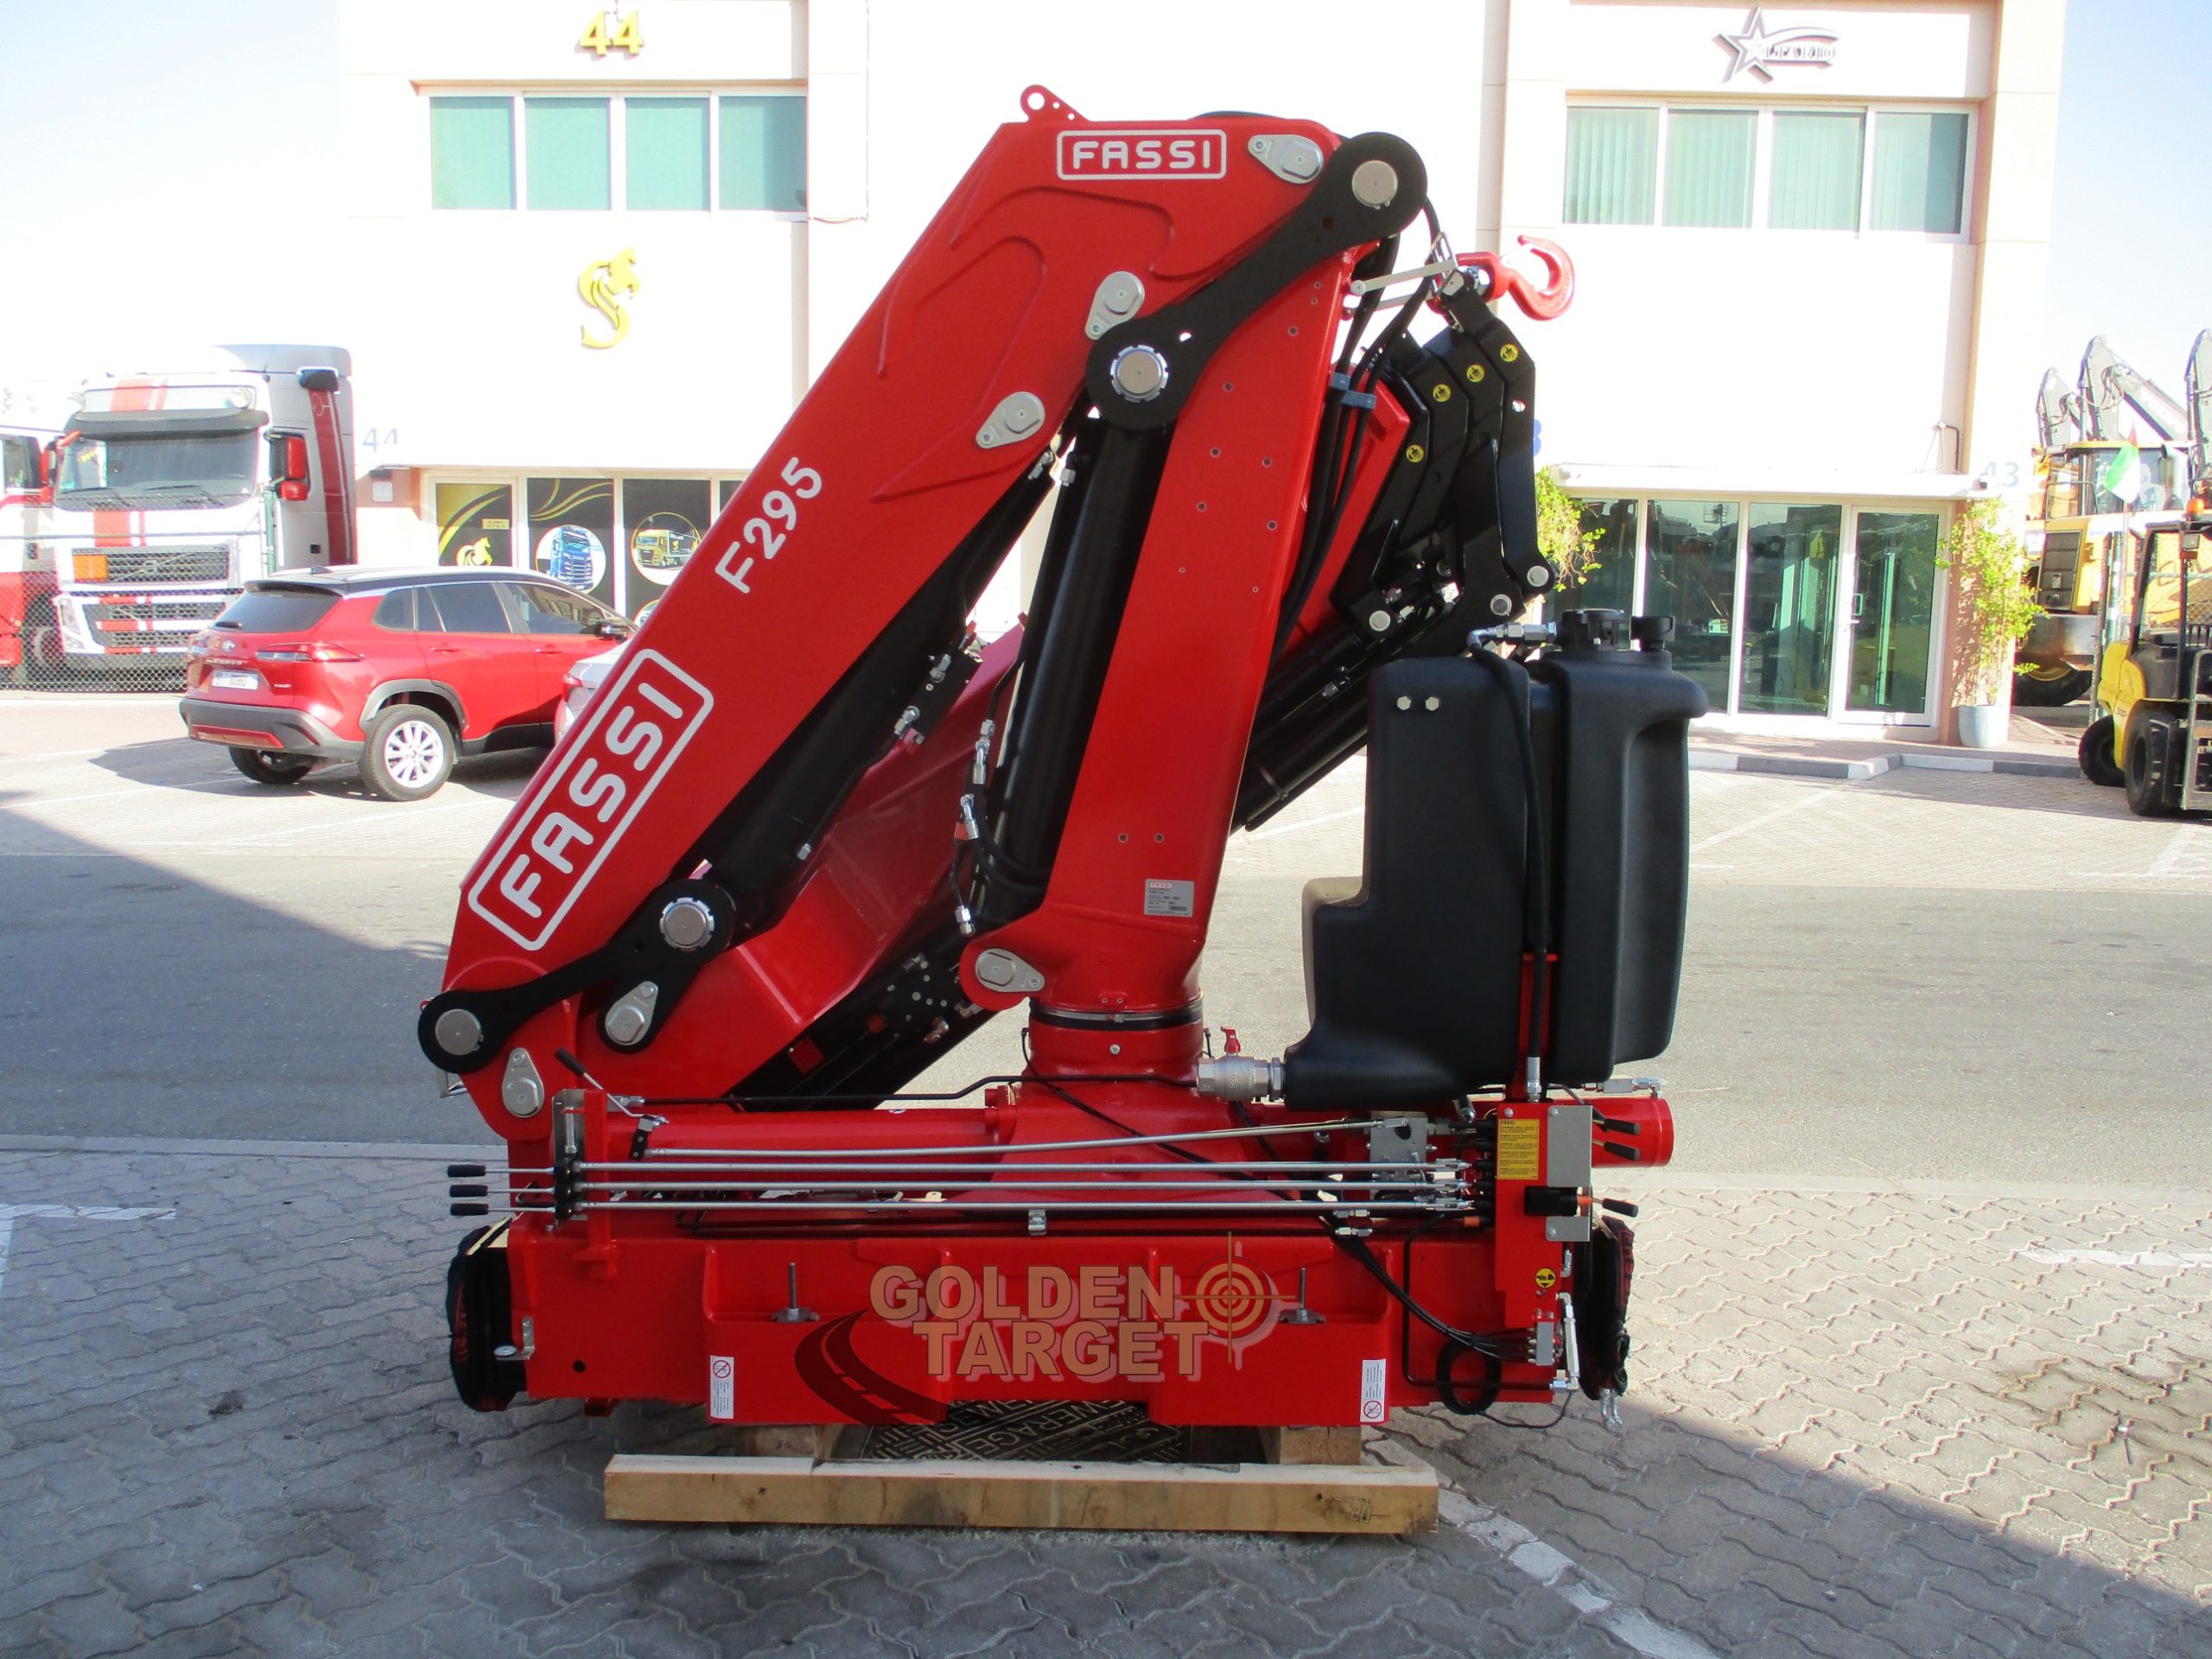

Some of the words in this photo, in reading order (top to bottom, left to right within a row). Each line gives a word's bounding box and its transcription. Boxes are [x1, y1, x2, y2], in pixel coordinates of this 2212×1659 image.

[580, 9, 645, 57] 44
[1072, 139, 1211, 169] FASSI
[715, 455, 823, 594] F295
[499, 681, 684, 919] FASSI
